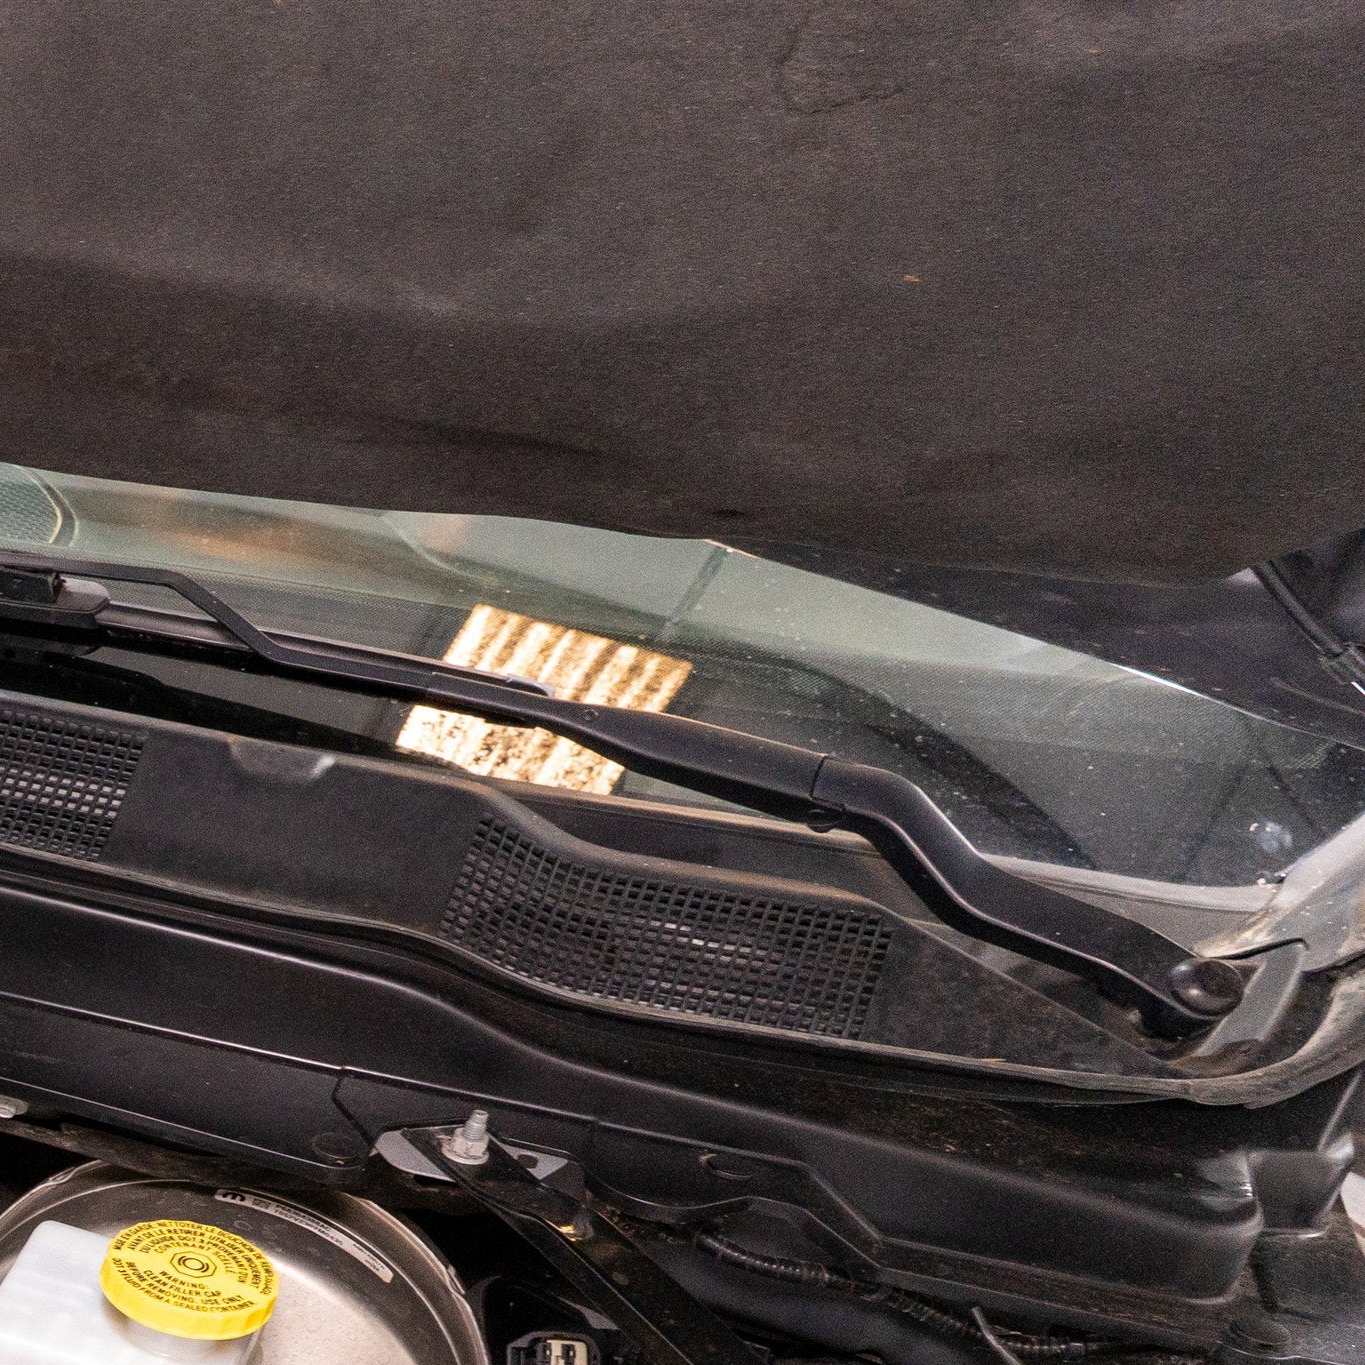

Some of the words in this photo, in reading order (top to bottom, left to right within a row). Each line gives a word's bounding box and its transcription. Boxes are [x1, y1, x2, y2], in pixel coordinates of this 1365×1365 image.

[152, 1240, 213, 1255] CONTENANT
[175, 1234, 197, 1242] DOT
[119, 1272, 144, 1289] FLUID
[136, 1285, 165, 1302] FROM
[171, 1299, 208, 1313] SEALED
[124, 1261, 150, 1283] BEFORE
[200, 1298, 222, 1306] USE
[142, 1269, 170, 1287] CLEAN
[166, 1283, 202, 1298] FILLER
[203, 1290, 223, 1298] CAP
